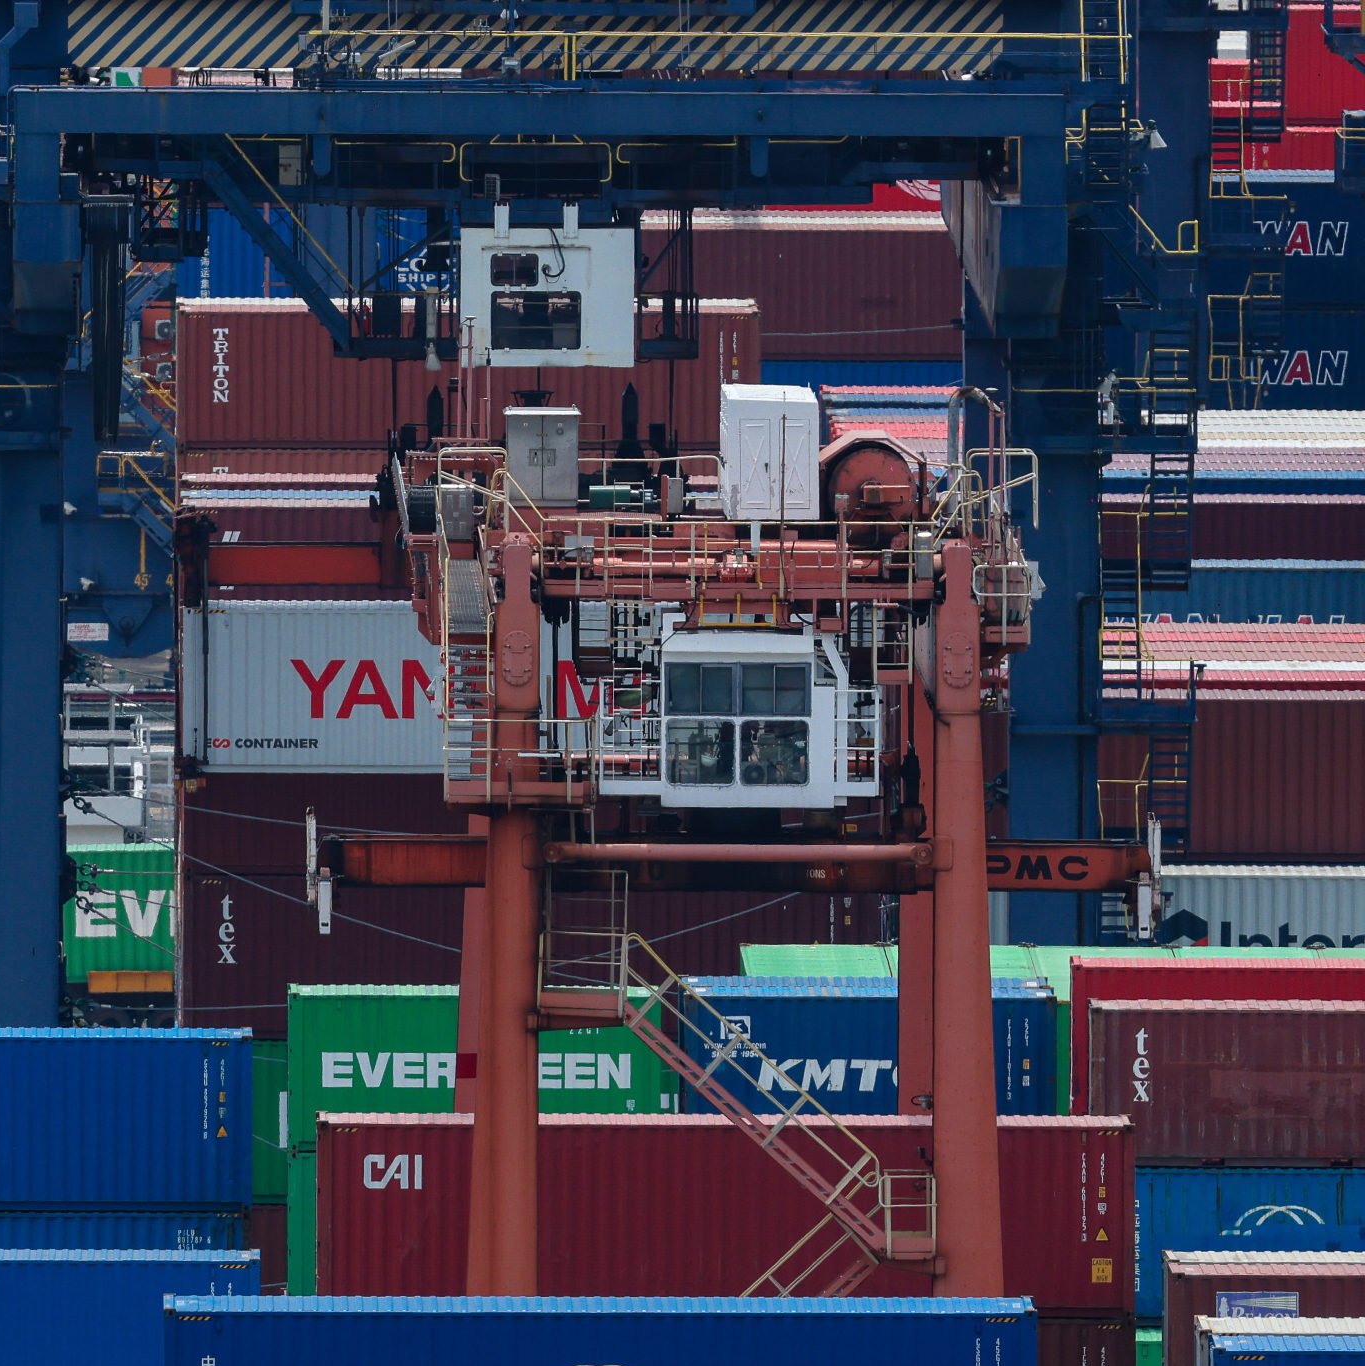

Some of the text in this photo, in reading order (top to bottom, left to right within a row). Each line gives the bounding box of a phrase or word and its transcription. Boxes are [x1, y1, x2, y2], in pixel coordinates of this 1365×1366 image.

[212, 327, 230, 403] TRITON
[234, 737, 320, 749] CONTAINER
[217, 893, 237, 965] tex
[757, 1057, 899, 1093] KMT
[1132, 1027, 1151, 1102] tex
[363, 1153, 424, 1190] CAI
